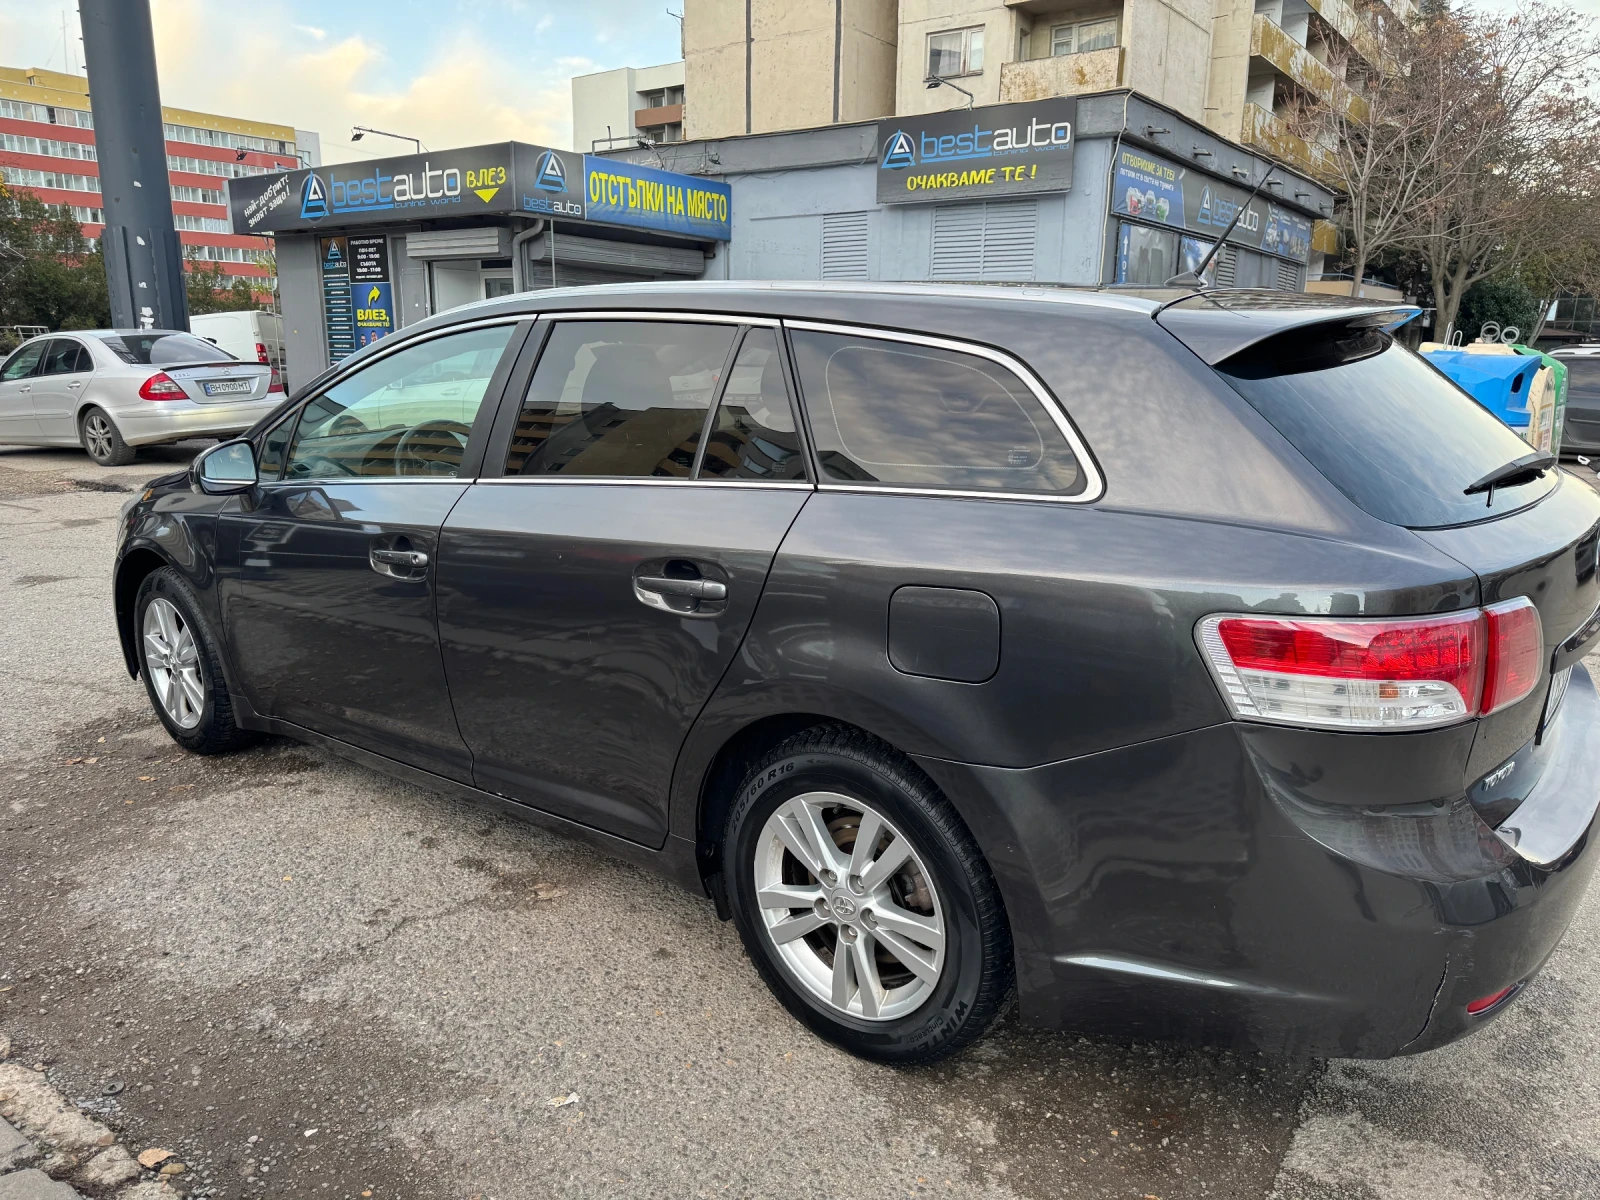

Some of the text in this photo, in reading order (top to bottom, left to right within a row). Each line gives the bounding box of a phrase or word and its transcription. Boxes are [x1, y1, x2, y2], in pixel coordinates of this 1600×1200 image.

[466, 166, 507, 188] ВЛЕЗ
[906, 169, 996, 190] ОЧАКВАМЕ
[1001, 165, 1026, 182] ТЕ
[589, 170, 727, 222] ОТСТЪПКИ НА МЯСТО
[248, 206, 268, 229] знаят
